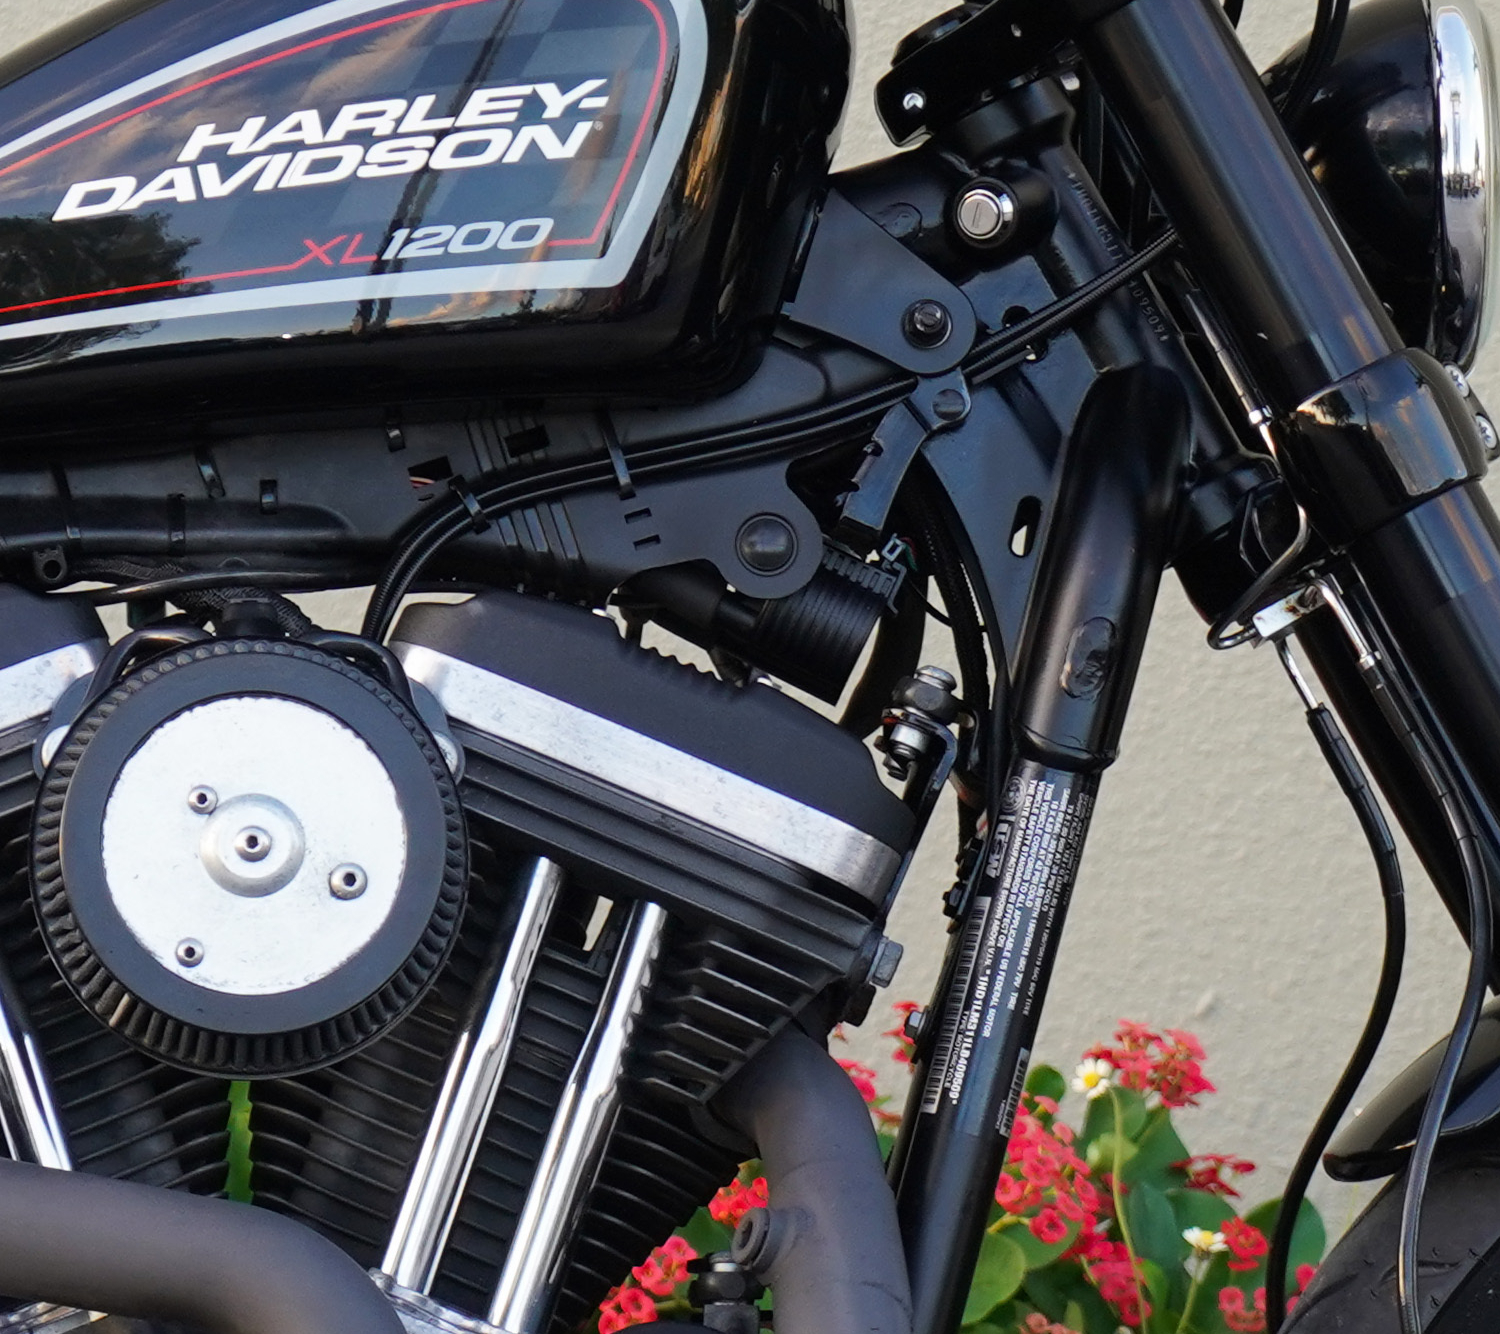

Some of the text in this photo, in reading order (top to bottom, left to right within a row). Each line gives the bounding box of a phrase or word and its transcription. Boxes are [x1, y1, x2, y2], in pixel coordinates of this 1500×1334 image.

[180, 77, 610, 158] HARLEY-
[52, 123, 596, 222] DAVIDSON
[297, 215, 553, 269] XL1200
[1021, 795, 1032, 816] DATE
[1026, 778, 1036, 794] THE
[1022, 814, 1037, 845] SAFETY
[1002, 829, 1023, 888] MANUFACTURE
[1010, 845, 1029, 893] STANDARDS
[1000, 903, 1014, 933] EFFECT
[1002, 909, 1022, 958] APPLICABLE
[990, 970, 1006, 1008] FEDERAL
[982, 1007, 997, 1038] MOTOR
